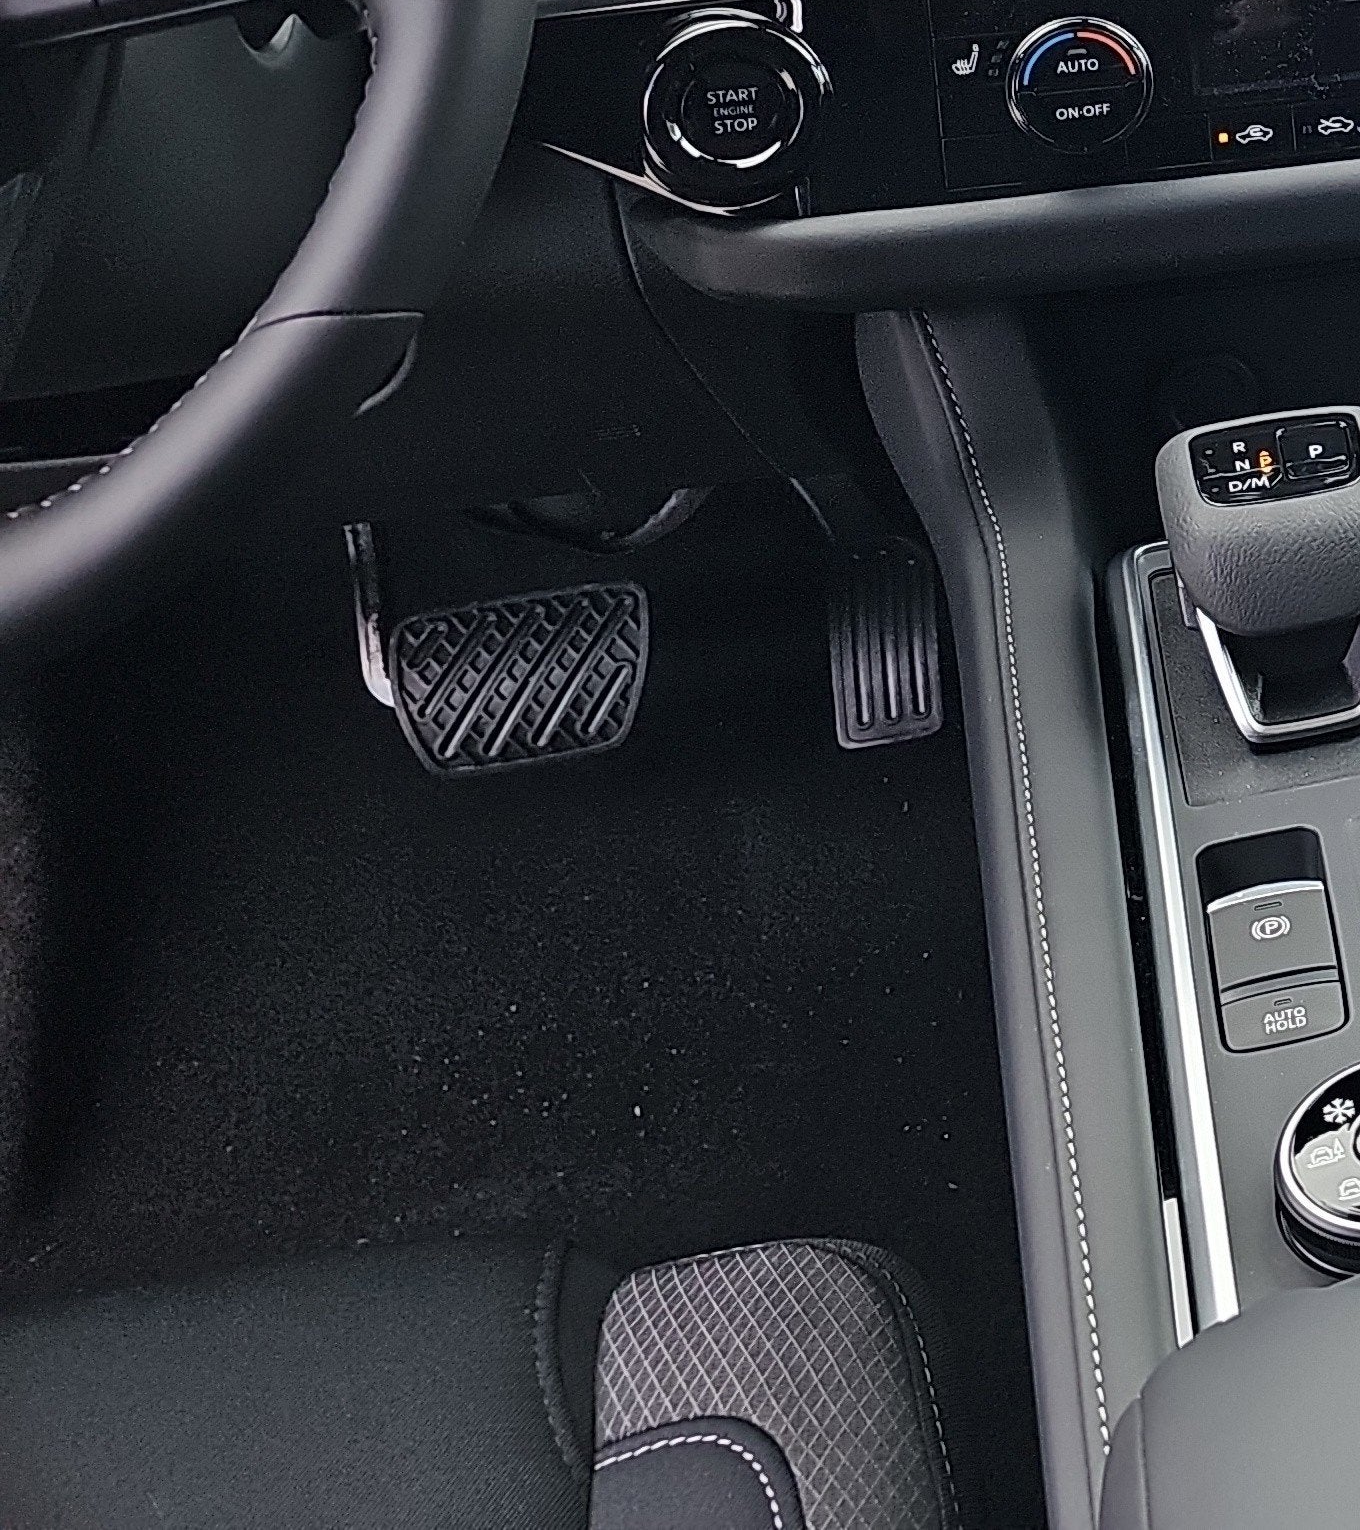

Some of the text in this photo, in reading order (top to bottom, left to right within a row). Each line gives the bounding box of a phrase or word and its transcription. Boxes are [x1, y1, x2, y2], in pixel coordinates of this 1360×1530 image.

[1056, 58, 1099, 74] AUTO
[706, 86, 759, 107] START
[713, 104, 755, 116] ENGINE
[714, 117, 758, 135] STOP
[1232, 441, 1246, 453] R
[1309, 445, 1323, 459] P
[1235, 459, 1250, 471] N
[1228, 476, 1271, 492] D/M
[1263, 1006, 1306, 1024] AUTO
[1265, 1016, 1307, 1034] HOLD
